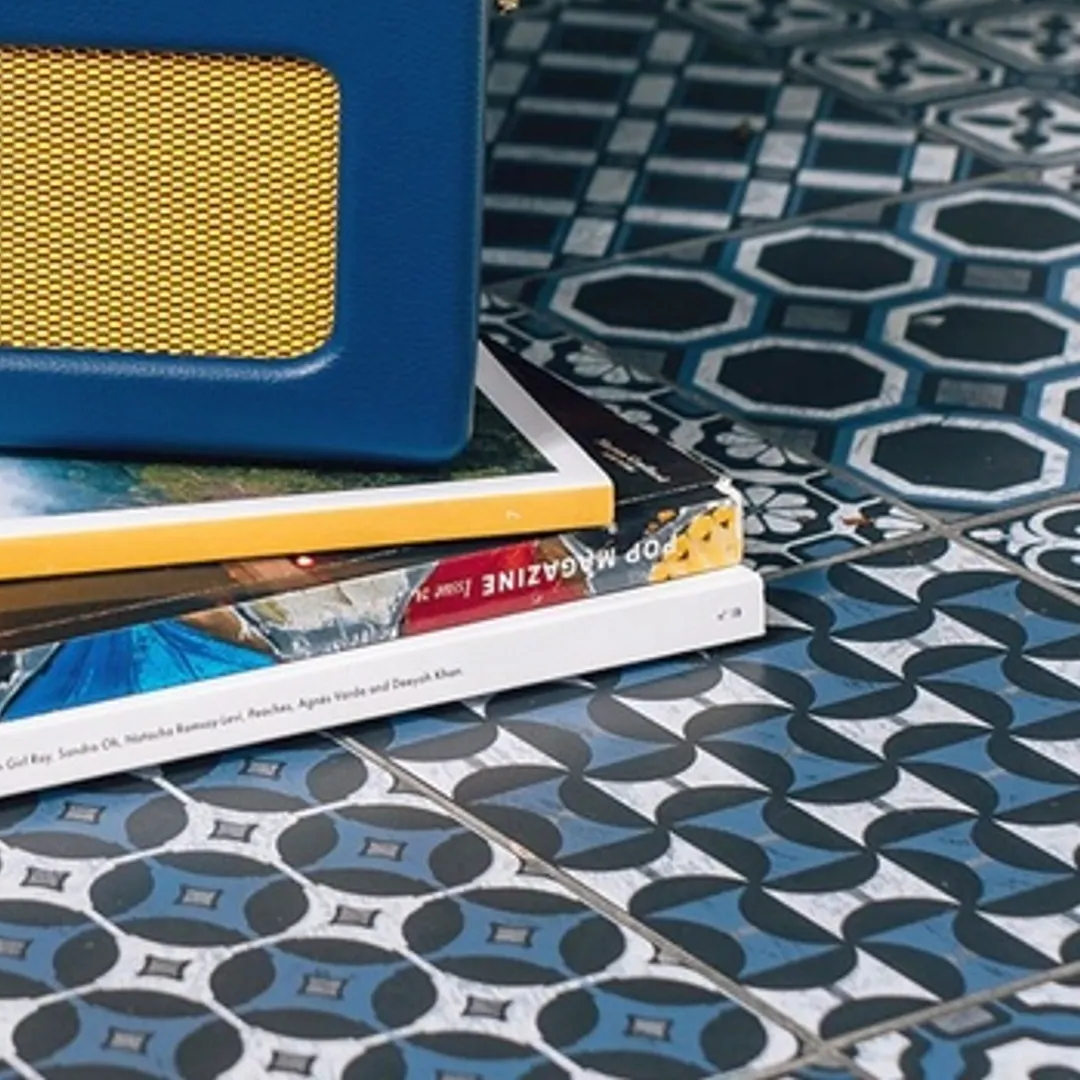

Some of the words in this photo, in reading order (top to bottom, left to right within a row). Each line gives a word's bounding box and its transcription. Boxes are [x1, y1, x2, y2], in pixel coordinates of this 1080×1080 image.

[625, 539, 677, 564] POP
[481, 547, 616, 597] MAGAZINE
[434, 578, 472, 601] Issue
[367, 679, 391, 696] and
